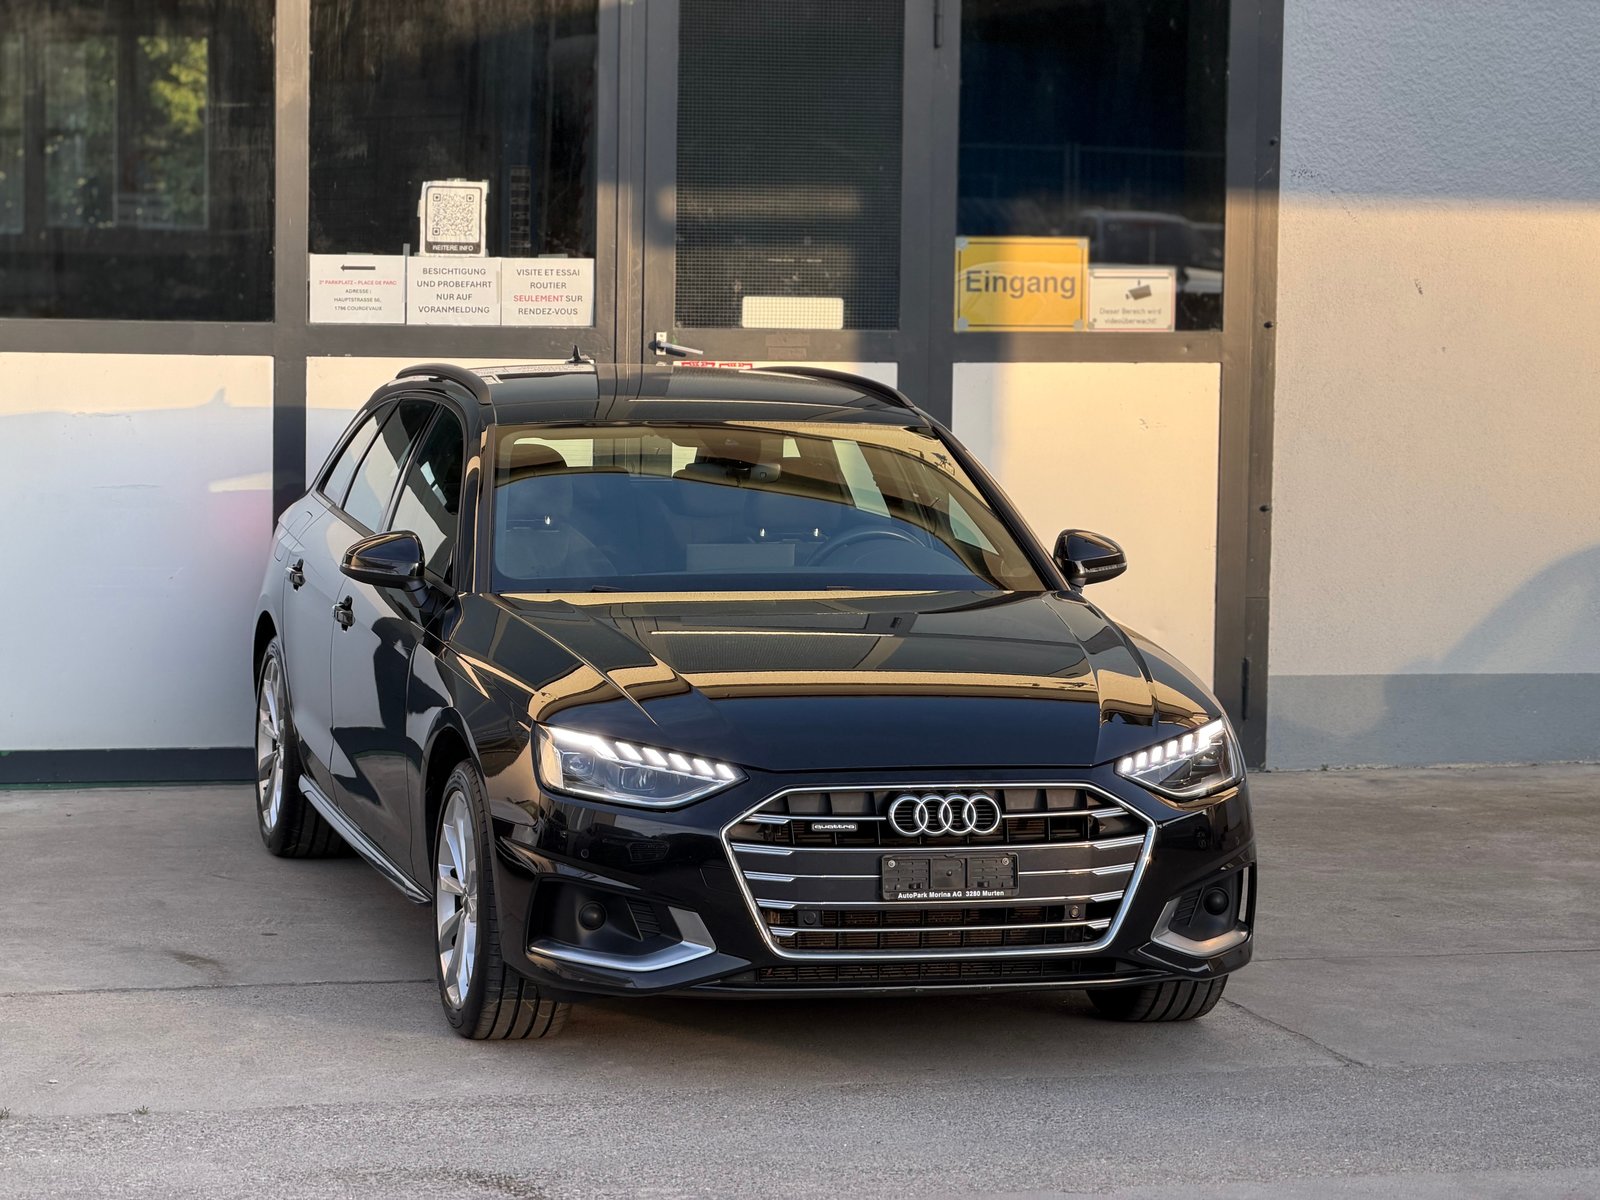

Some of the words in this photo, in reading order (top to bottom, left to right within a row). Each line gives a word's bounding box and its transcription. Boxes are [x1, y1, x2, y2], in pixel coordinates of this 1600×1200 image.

[422, 267, 487, 275] BESICHTIGUNG
[516, 268, 543, 276] VISITE
[544, 268, 554, 276] ET
[416, 280, 436, 288] UND
[437, 280, 493, 288] PROBEFAHRT
[530, 281, 567, 289] ROUTIER
[965, 270, 1076, 299] Eingang
[436, 293, 455, 301] NUR
[456, 293, 473, 301] AUF
[513, 294, 564, 302] SEULEMENT
[418, 306, 490, 314] VORANMELDUNG
